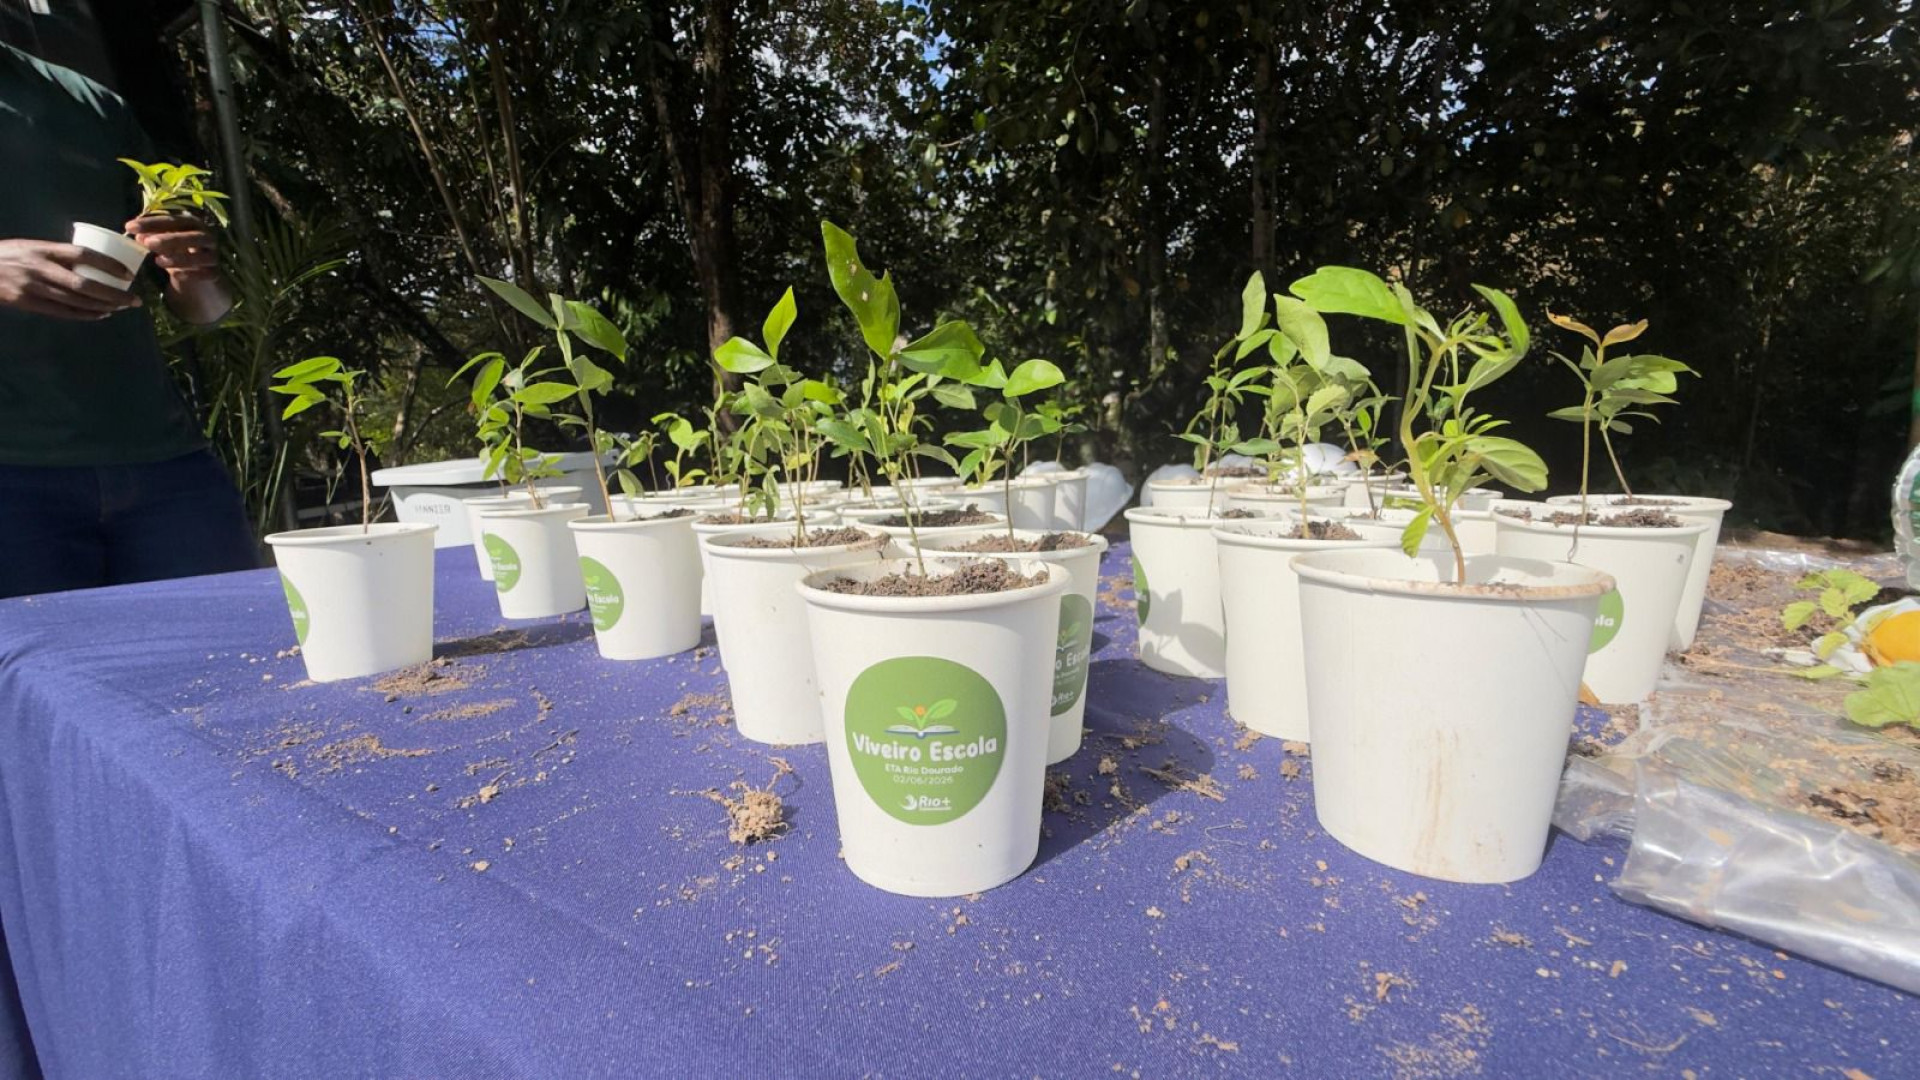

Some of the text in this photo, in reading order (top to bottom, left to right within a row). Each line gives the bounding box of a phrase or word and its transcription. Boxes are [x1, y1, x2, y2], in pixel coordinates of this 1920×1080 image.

[852, 732, 997, 761] Viveiro Escola
[885, 763, 963, 775] ETA Rio Dourado
